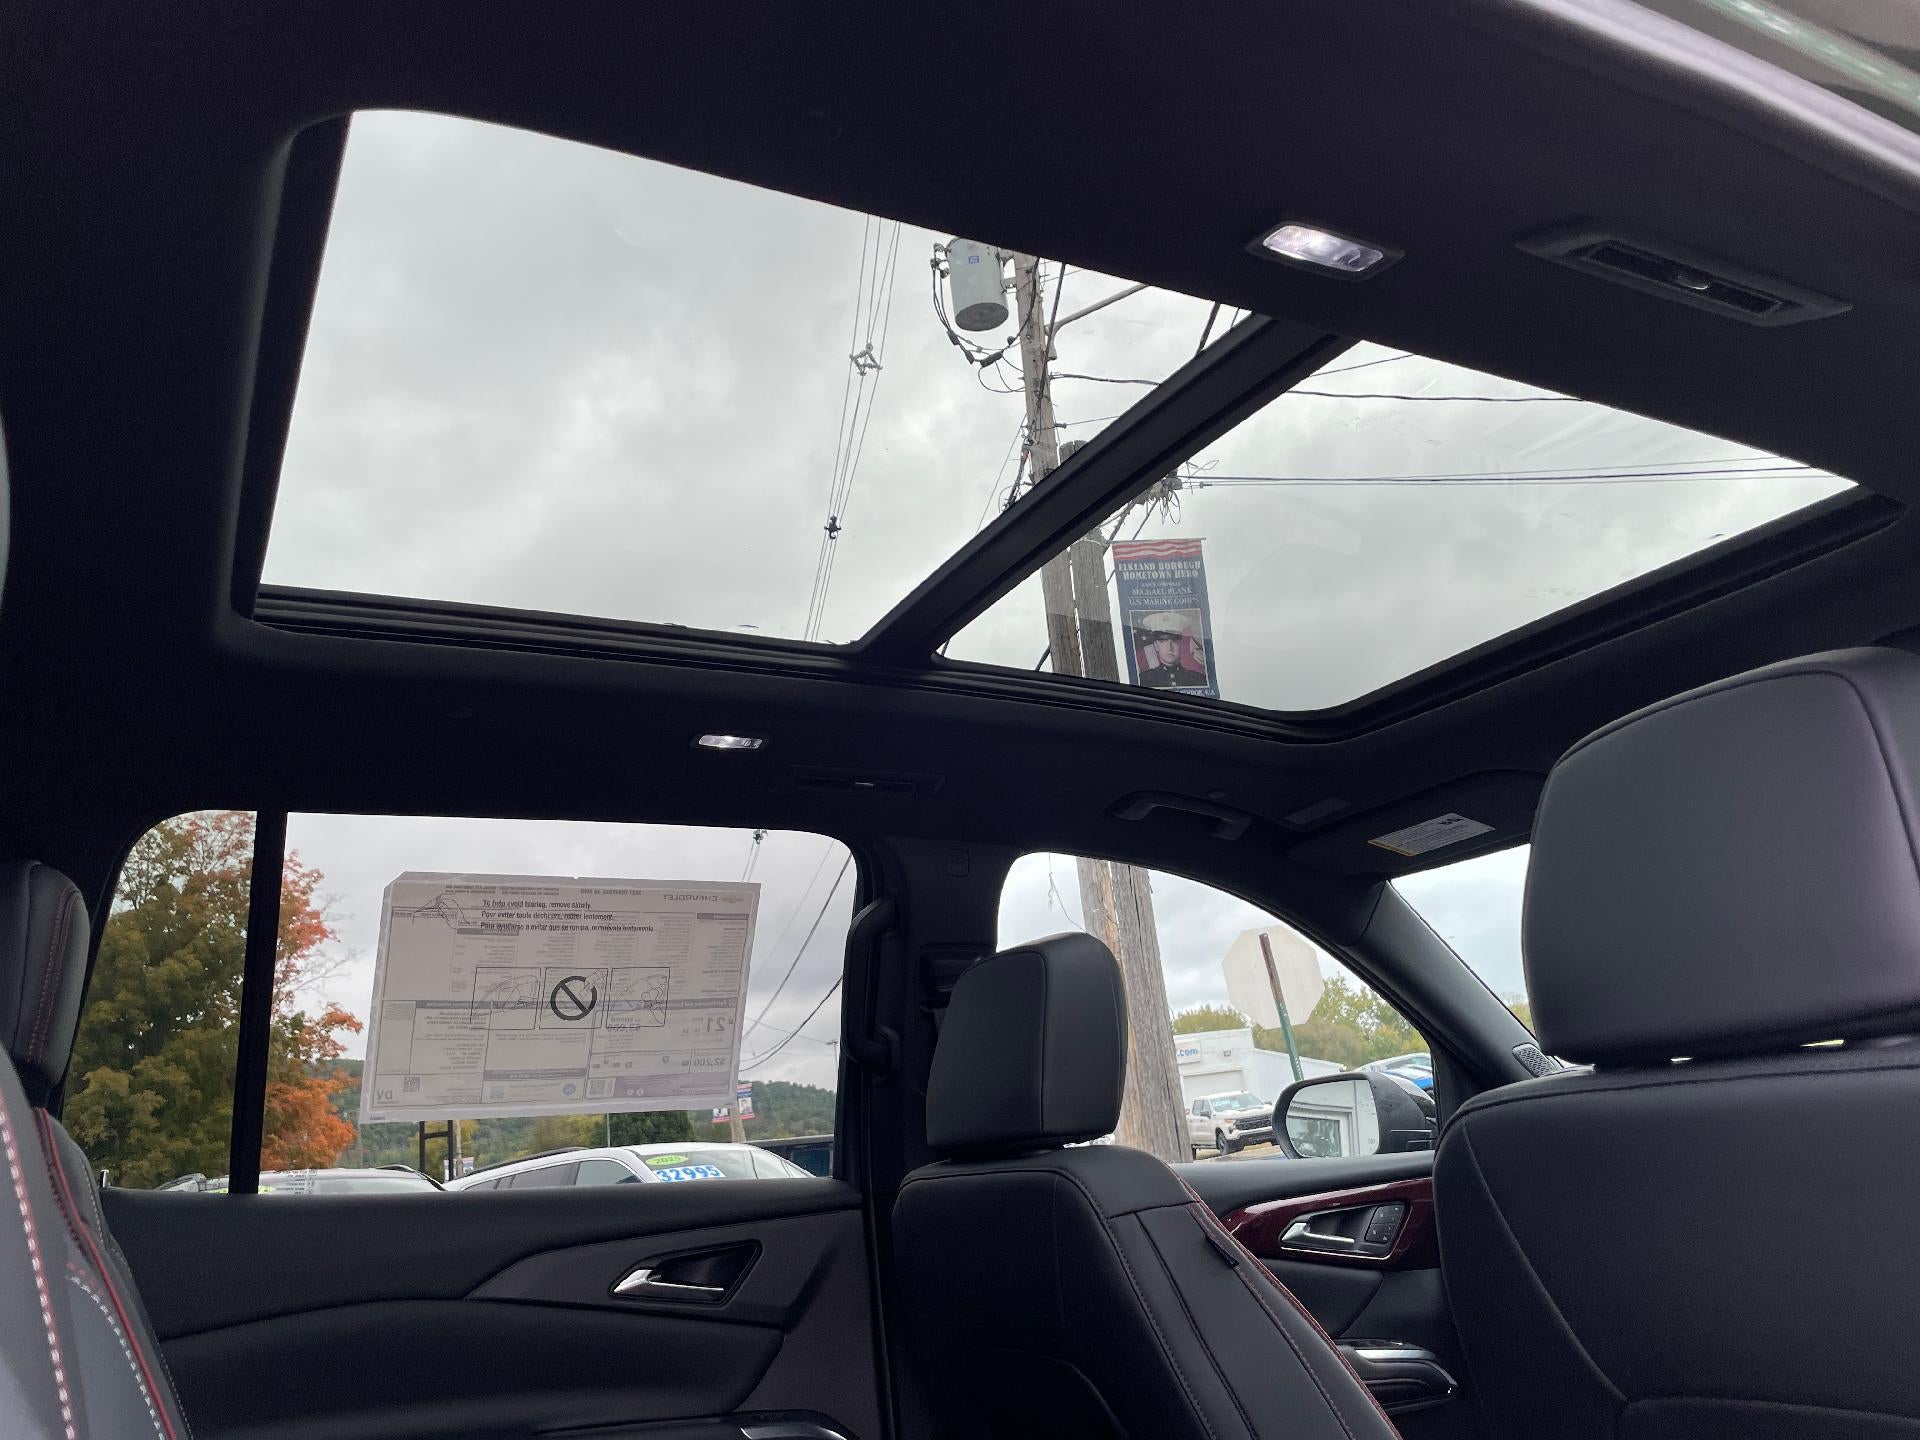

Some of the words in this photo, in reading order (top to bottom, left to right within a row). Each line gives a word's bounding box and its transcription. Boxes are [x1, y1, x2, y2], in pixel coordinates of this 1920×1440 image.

[1118, 562, 1156, 571] ELKLAND
[1158, 560, 1201, 570] BOROUGH
[1122, 570, 1172, 580] HOMETOWN
[1174, 569, 1199, 579] HERO
[483, 899, 490, 907] To
[656, 1166, 721, 1182] 32995
